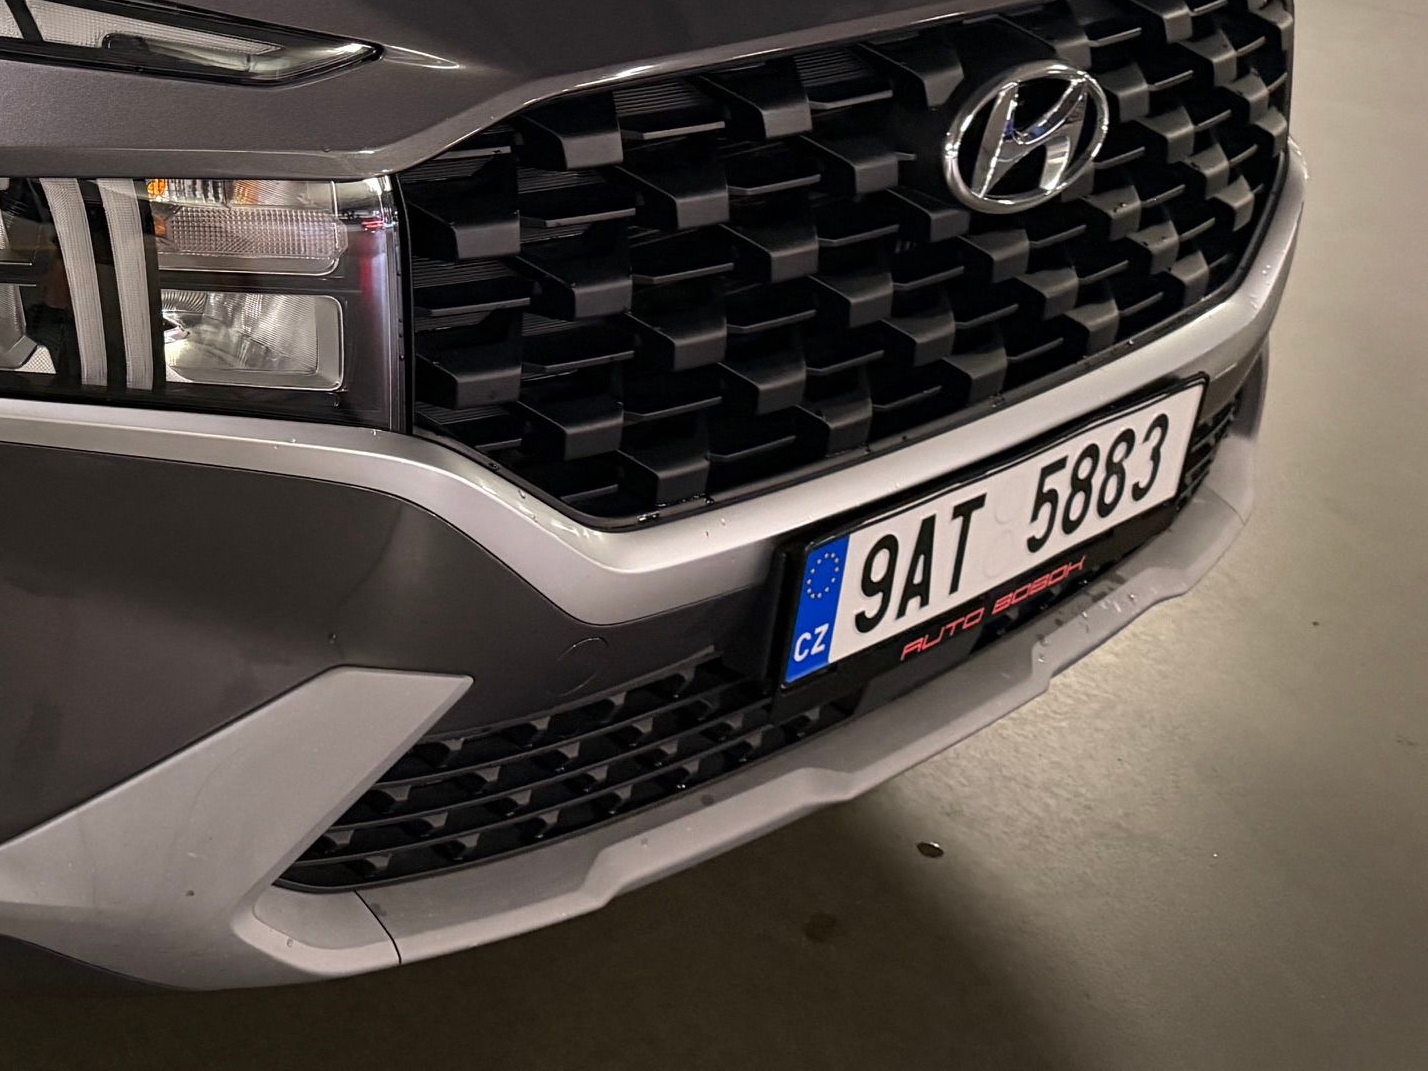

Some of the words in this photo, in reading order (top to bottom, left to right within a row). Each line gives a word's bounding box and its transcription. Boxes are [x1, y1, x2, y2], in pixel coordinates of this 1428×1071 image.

[854, 493, 988, 633] 9AT
[1026, 413, 1170, 553] 5883
[793, 623, 830, 662] CZ
[900, 607, 986, 661] AUTO
[992, 555, 1086, 615] BOSCH
